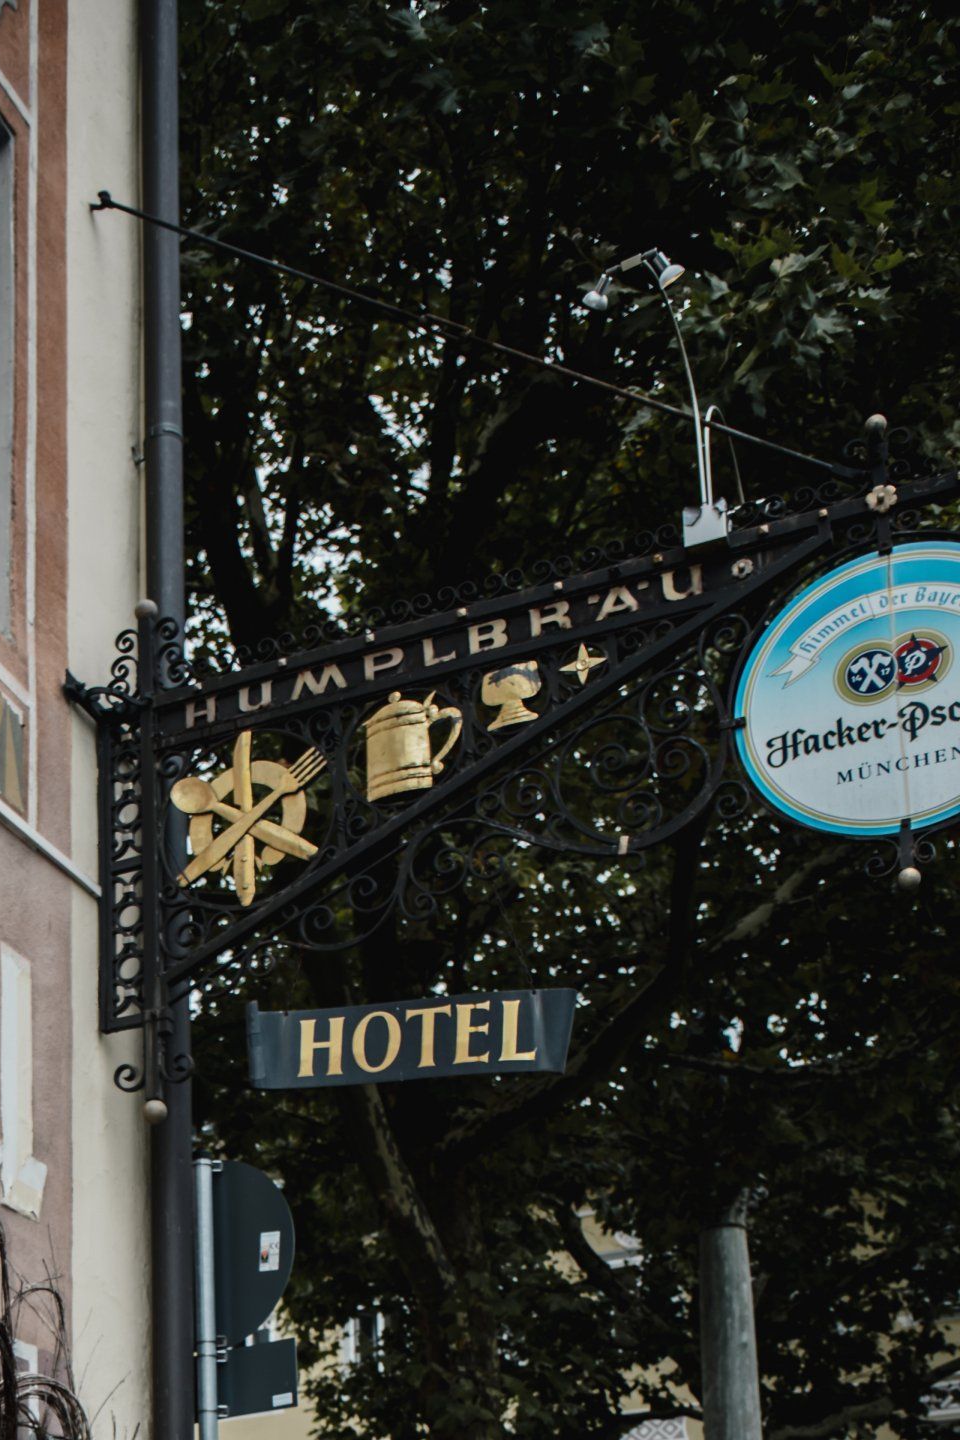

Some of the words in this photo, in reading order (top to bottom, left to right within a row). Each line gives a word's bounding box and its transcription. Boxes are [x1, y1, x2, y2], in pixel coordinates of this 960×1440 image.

[879, 592, 908, 609] der
[185, 563, 704, 729] HUMPLBRÄU
[766, 700, 960, 769] Hacker-Psc
[297, 999, 538, 1078] HOTEL
